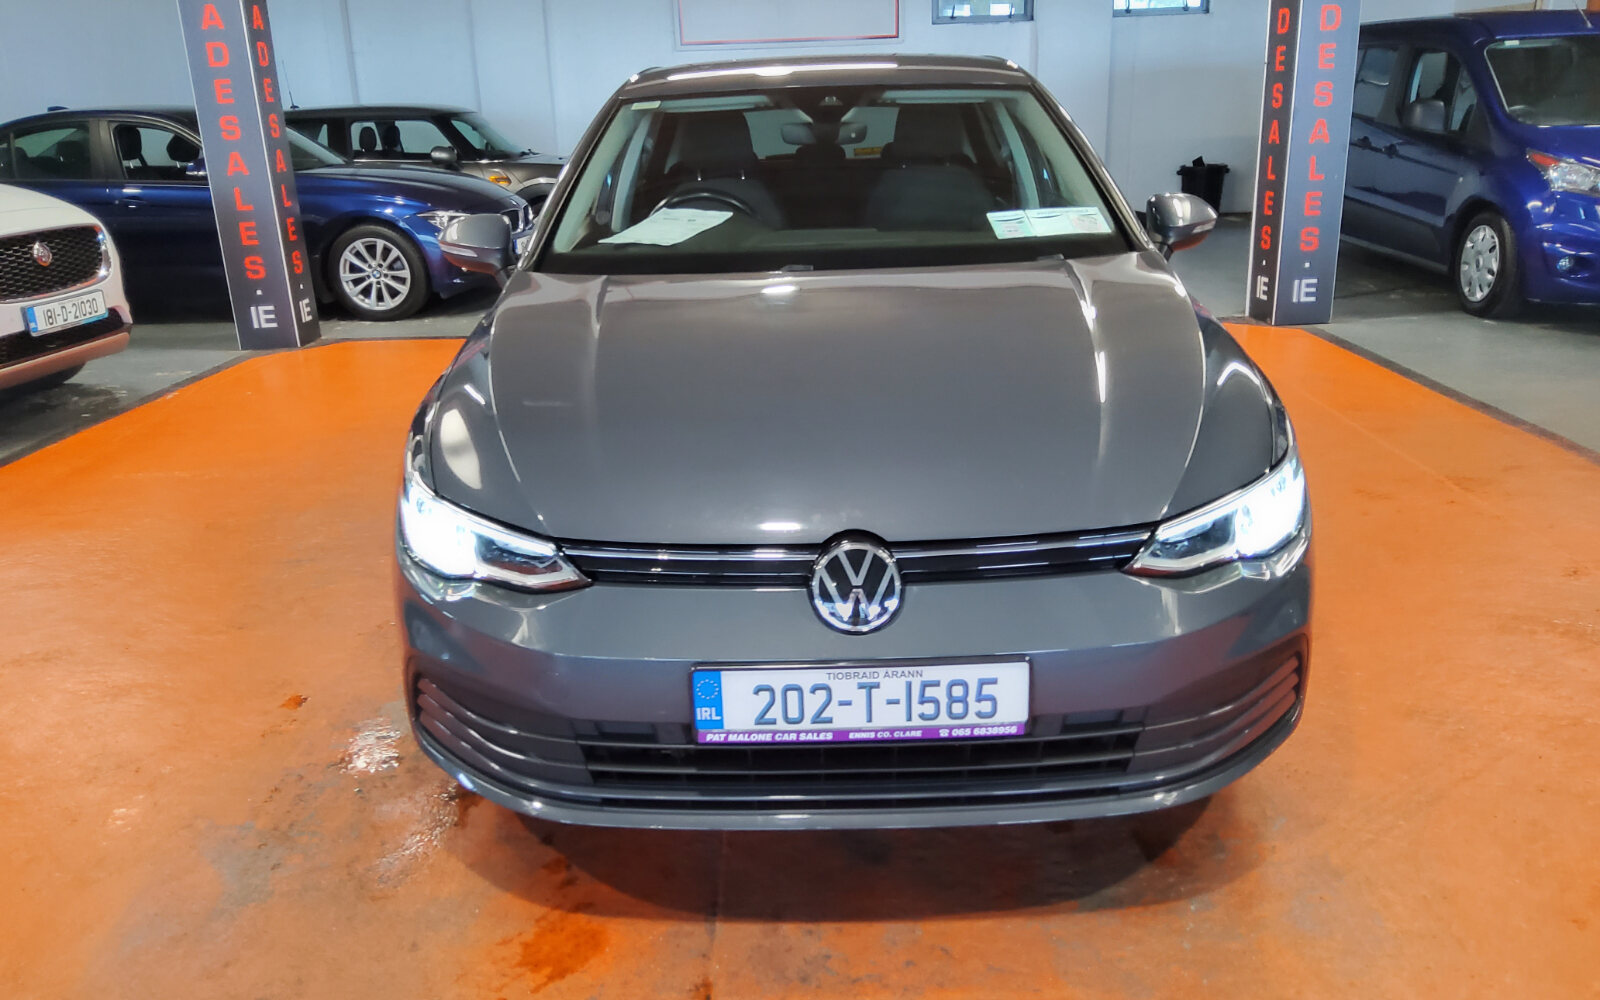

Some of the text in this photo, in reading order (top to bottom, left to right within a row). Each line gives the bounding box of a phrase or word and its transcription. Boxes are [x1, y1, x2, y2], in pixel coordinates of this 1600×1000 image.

[42, 298, 99, 327] 181-D-21030
[826, 671, 880, 681] TIOBRAID
[752, 677, 999, 726] 202-T-1585
[696, 707, 722, 720] IRL
[706, 733, 727, 742] PAT
[728, 733, 773, 742] MALONE
[775, 732, 798, 741] CAR
[799, 732, 833, 741] SALES
[849, 731, 876, 739] ENNIS
[877, 730, 892, 739] CO.
[893, 729, 923, 738] CLARE
[951, 727, 971, 737] 065
